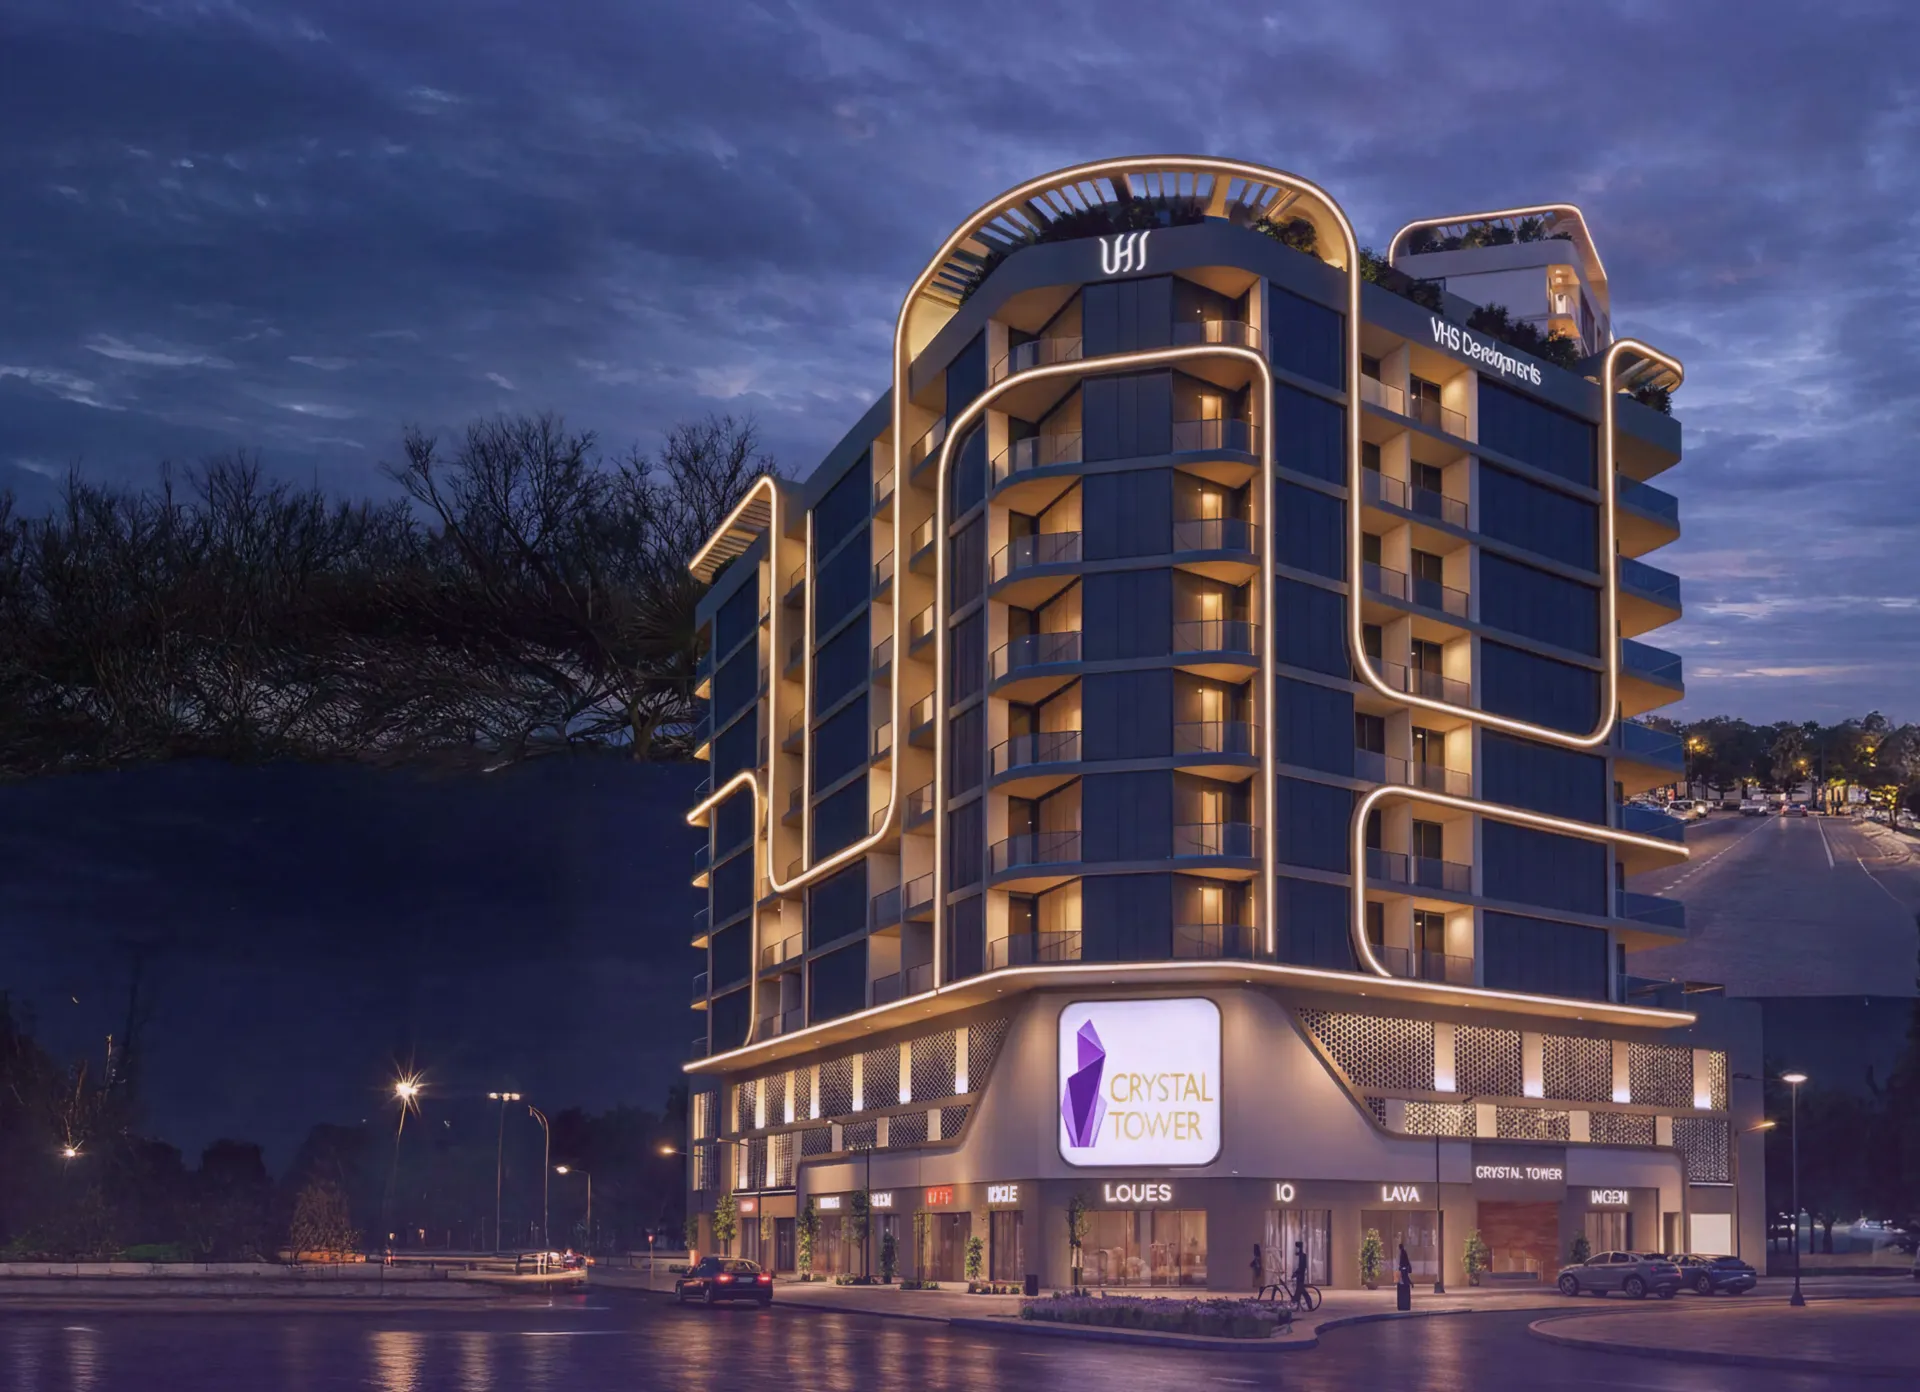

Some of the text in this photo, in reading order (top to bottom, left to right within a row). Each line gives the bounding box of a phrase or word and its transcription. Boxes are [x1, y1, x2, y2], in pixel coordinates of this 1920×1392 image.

[1430, 316, 1461, 352] VHS
[1110, 1073, 1214, 1103] CRYSTAL
[1108, 1111, 1203, 1141] TOWER
[1525, 1167, 1563, 1181] TOWER
[1104, 1183, 1172, 1203] LOUES
[1382, 1185, 1421, 1203] LAVA
